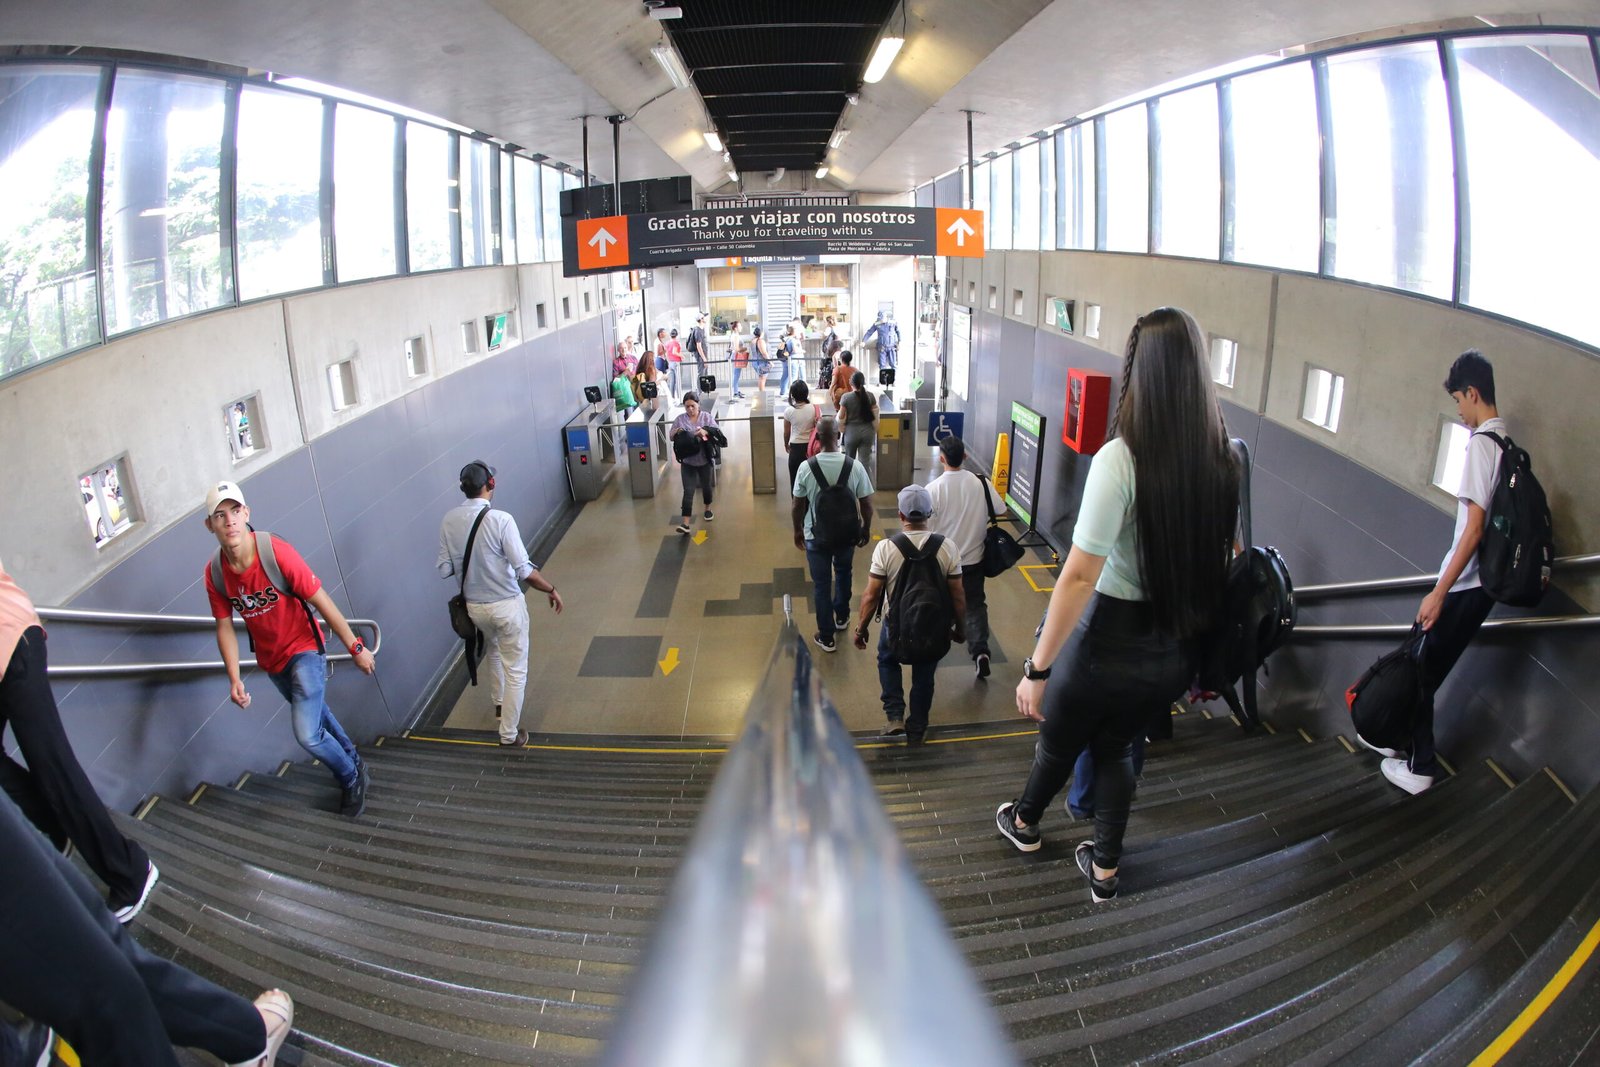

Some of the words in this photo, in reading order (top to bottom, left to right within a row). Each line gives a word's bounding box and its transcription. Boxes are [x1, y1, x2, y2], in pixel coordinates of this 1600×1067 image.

[648, 214, 709, 230] Gracias
[716, 214, 744, 229] por
[751, 211, 800, 227] viajar
[807, 212, 836, 224] con
[843, 211, 916, 224] nosotros
[692, 229, 725, 240] Thank
[729, 230, 750, 240] you
[753, 227, 772, 237] for
[776, 226, 828, 238] traveling
[832, 225, 857, 236] with
[860, 228, 873, 236] us
[228, 586, 280, 612] BOSS
